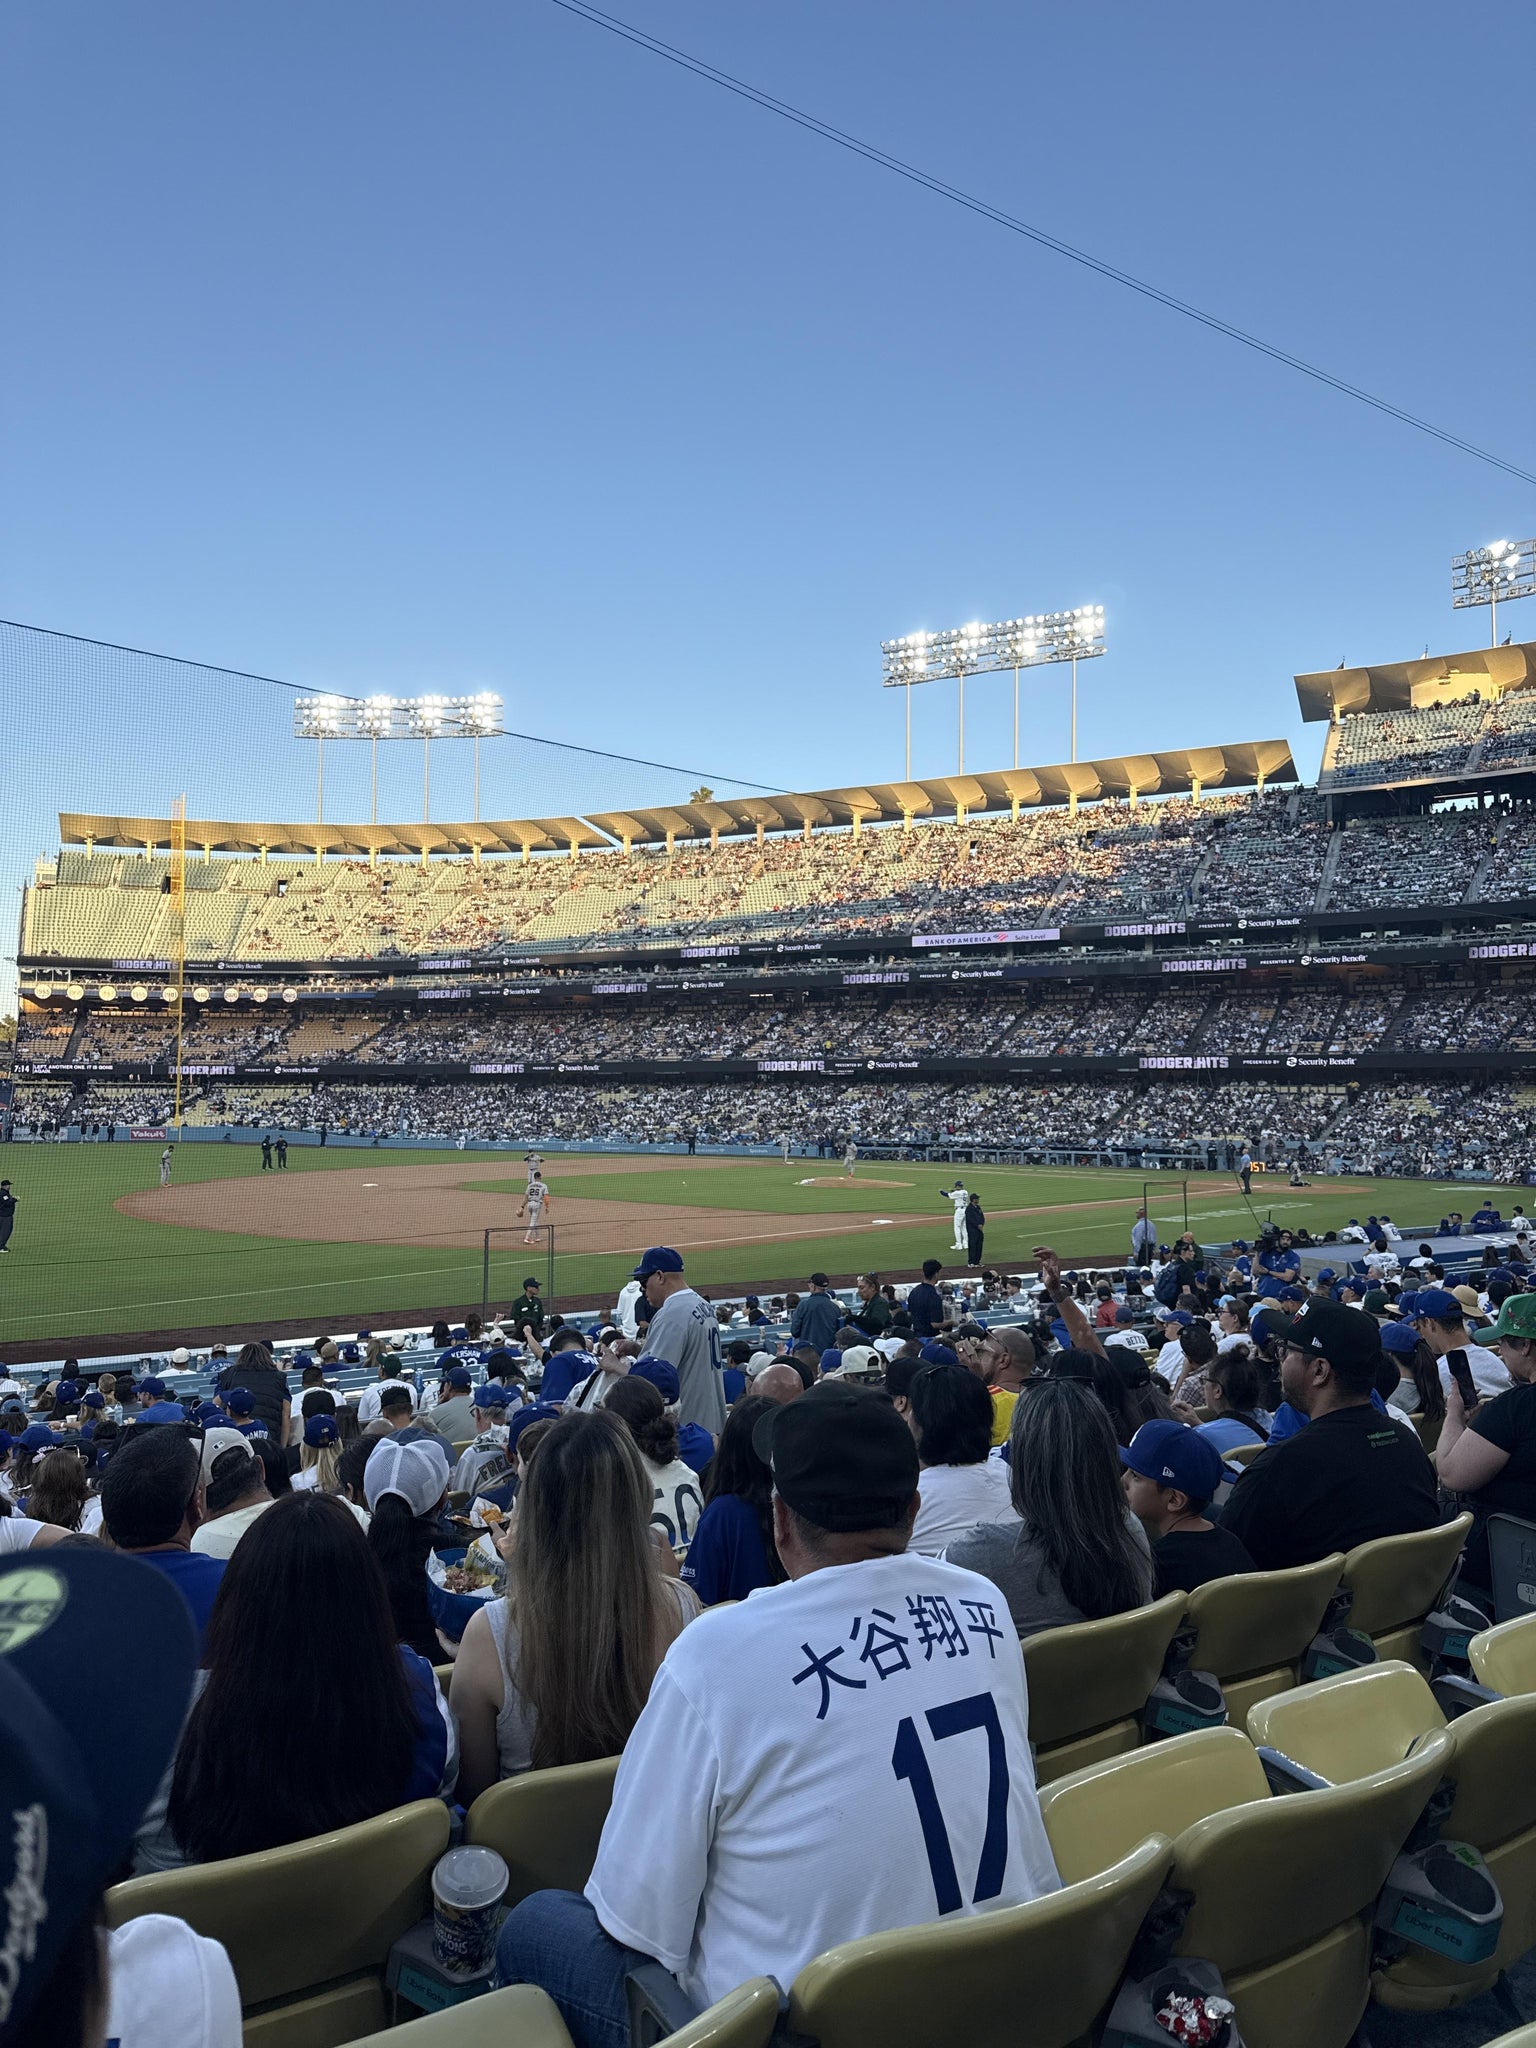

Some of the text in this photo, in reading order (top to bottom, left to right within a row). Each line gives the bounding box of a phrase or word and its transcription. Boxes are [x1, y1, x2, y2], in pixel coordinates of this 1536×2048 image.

[1248, 918, 1300, 928] Security Benefit
[1104, 922, 1186, 936] DODGER HITS
[680, 946, 740, 958] DODGER HITS
[1469, 944, 1528, 958] DODGER
[1162, 958, 1247, 972] DODGER HITS
[1312, 956, 1341, 964] Security
[843, 972, 909, 984] DODGER HITS
[592, 983, 648, 993] DODGER HITS
[758, 1060, 824, 1071] DODGER HITS
[1139, 1057, 1229, 1069] DODGER HITS
[1298, 1057, 1355, 1067] Security Benefit
[469, 1064, 524, 1073] DODGER HITS
[131, 1130, 165, 1138] Yakult
[1126, 1336, 1146, 1346] BETTS
[1525, 1585, 1535, 1594] 33
[792, 1594, 1004, 1720] 大谷翔平
[891, 1692, 1009, 1916] 17
[1406, 1915, 1462, 1946] Uber Eats
